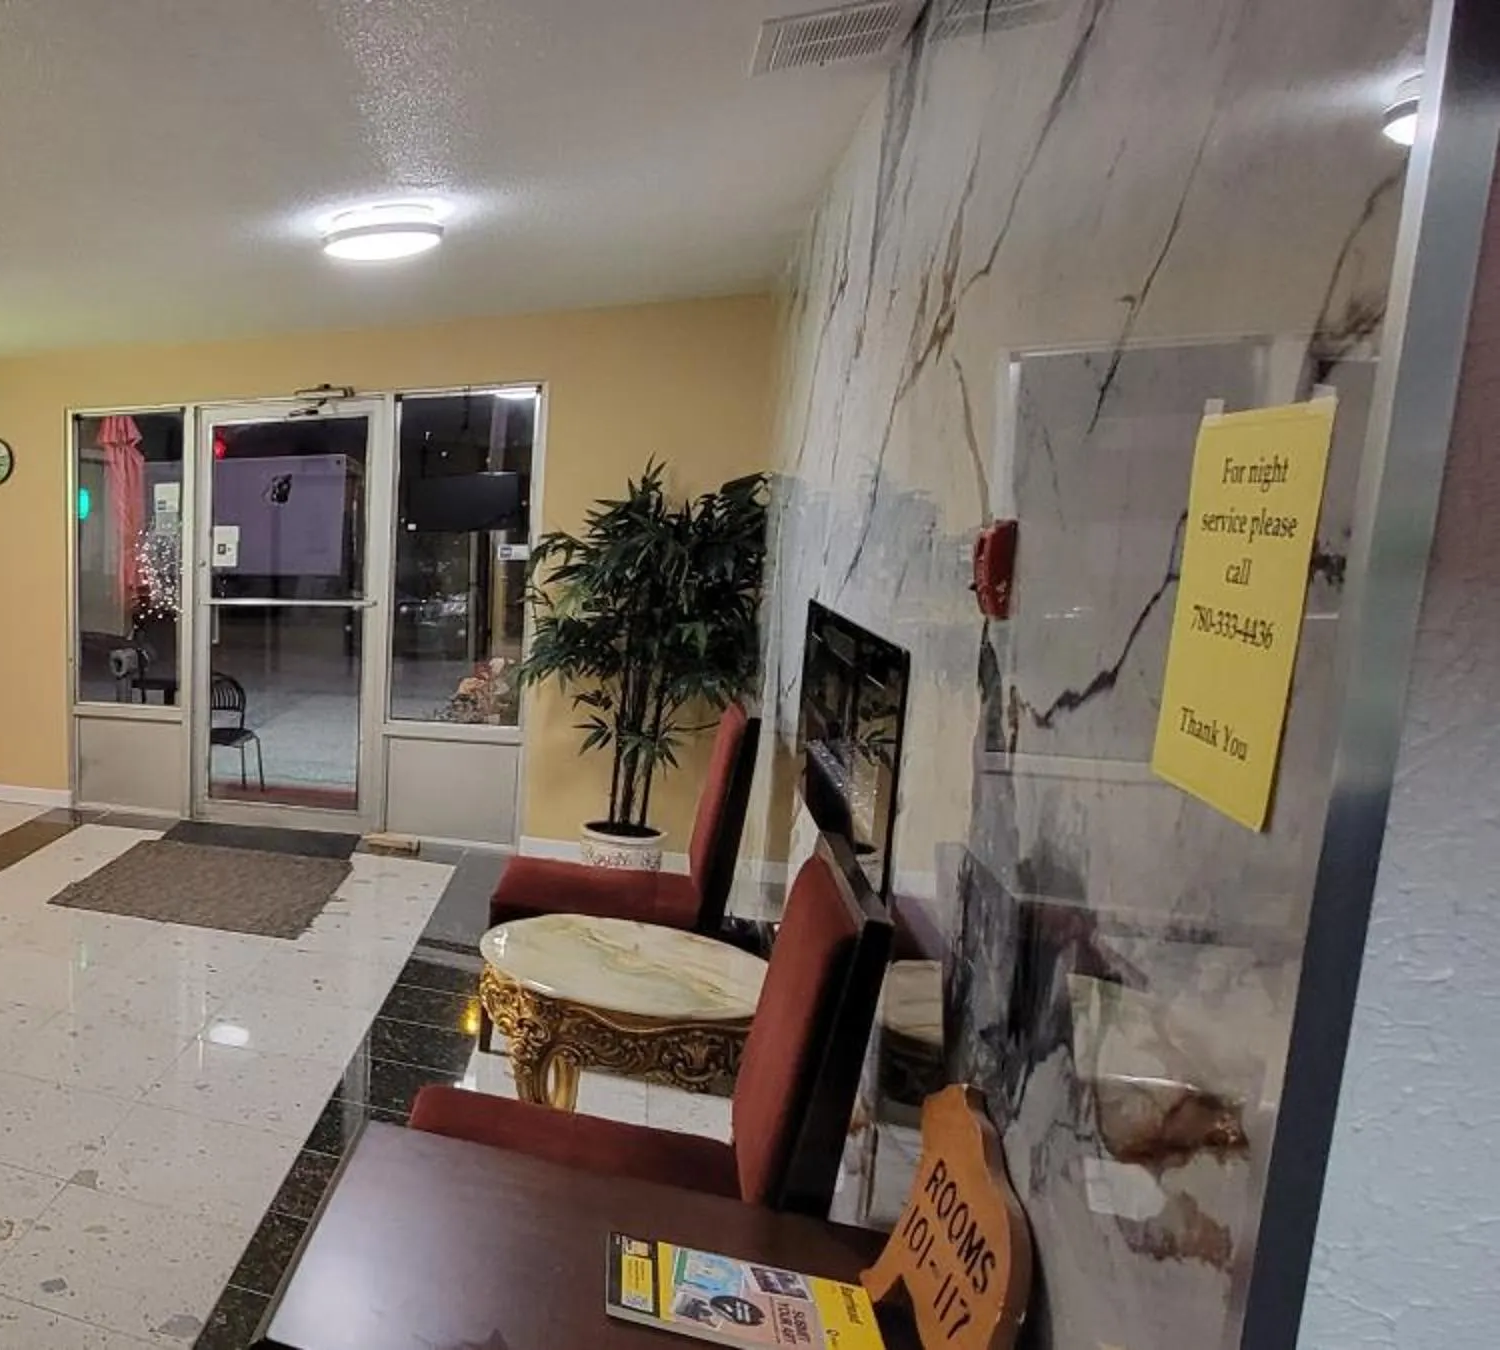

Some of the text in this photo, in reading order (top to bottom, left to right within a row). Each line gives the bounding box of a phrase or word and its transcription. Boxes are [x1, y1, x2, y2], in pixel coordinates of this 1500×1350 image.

[1221, 454, 1289, 493] For night
[1201, 506, 1299, 543] service please
[1225, 558, 1252, 585] call
[1190, 604, 1275, 649] 780-333-4436
[1180, 706, 1248, 761] Thank You
[924, 1157, 996, 1295] ROOMS
[902, 1203, 972, 1340] 101-117
